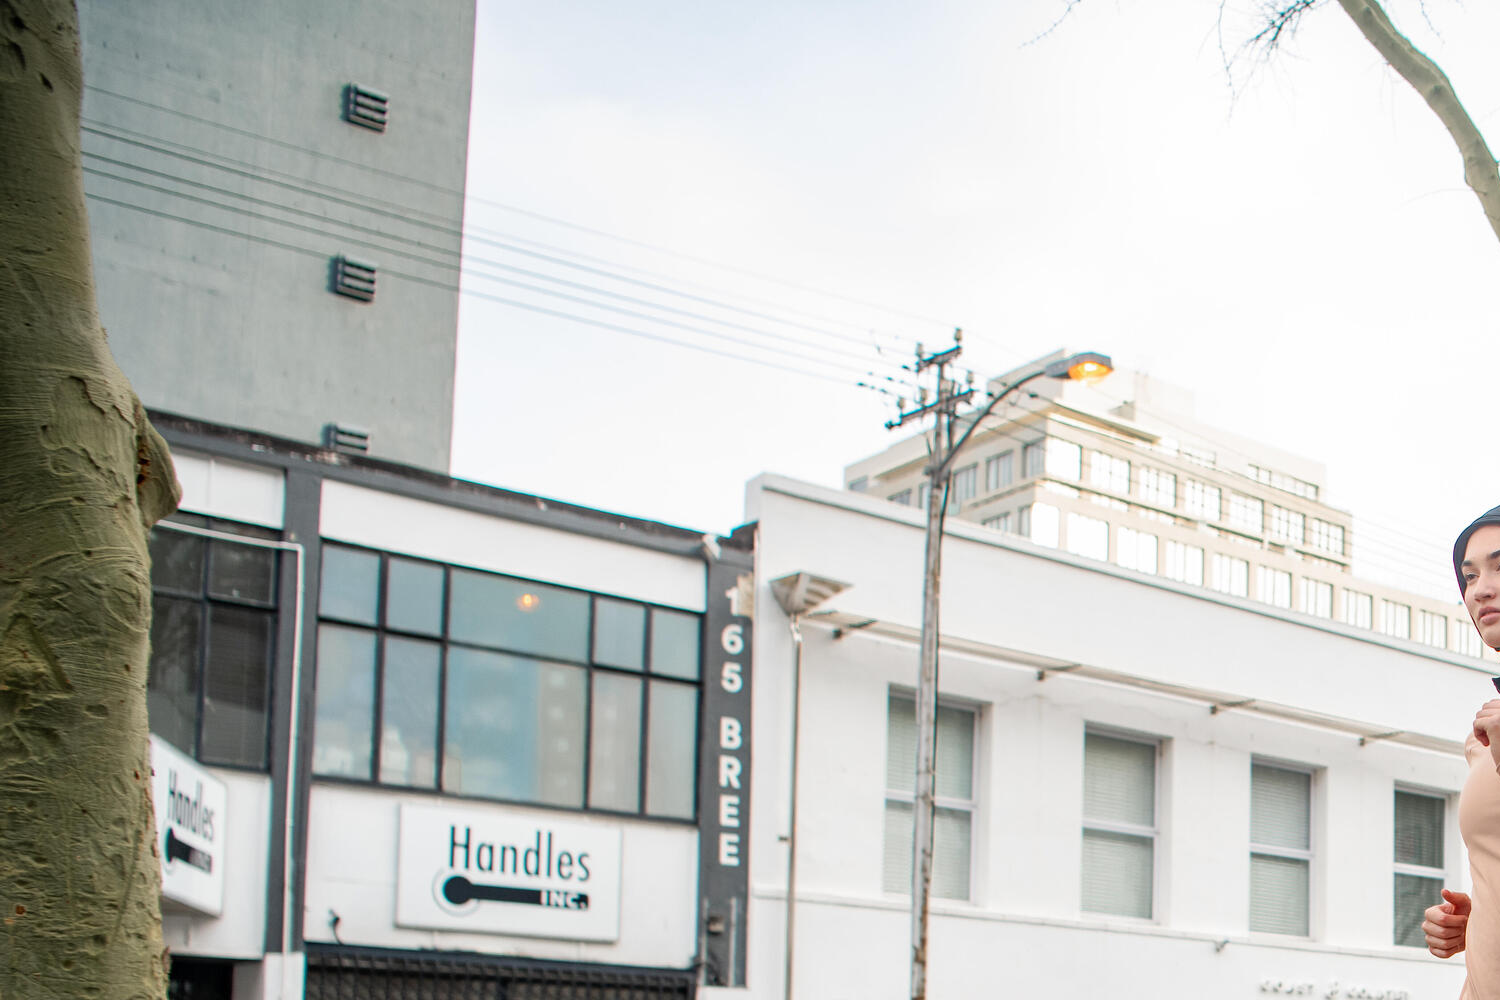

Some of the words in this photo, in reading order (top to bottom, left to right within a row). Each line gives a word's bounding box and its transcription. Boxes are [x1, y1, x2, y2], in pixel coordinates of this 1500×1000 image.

[167, 767, 214, 842] Handles
[718, 716, 743, 867] BREE
[449, 825, 591, 882] Handles
